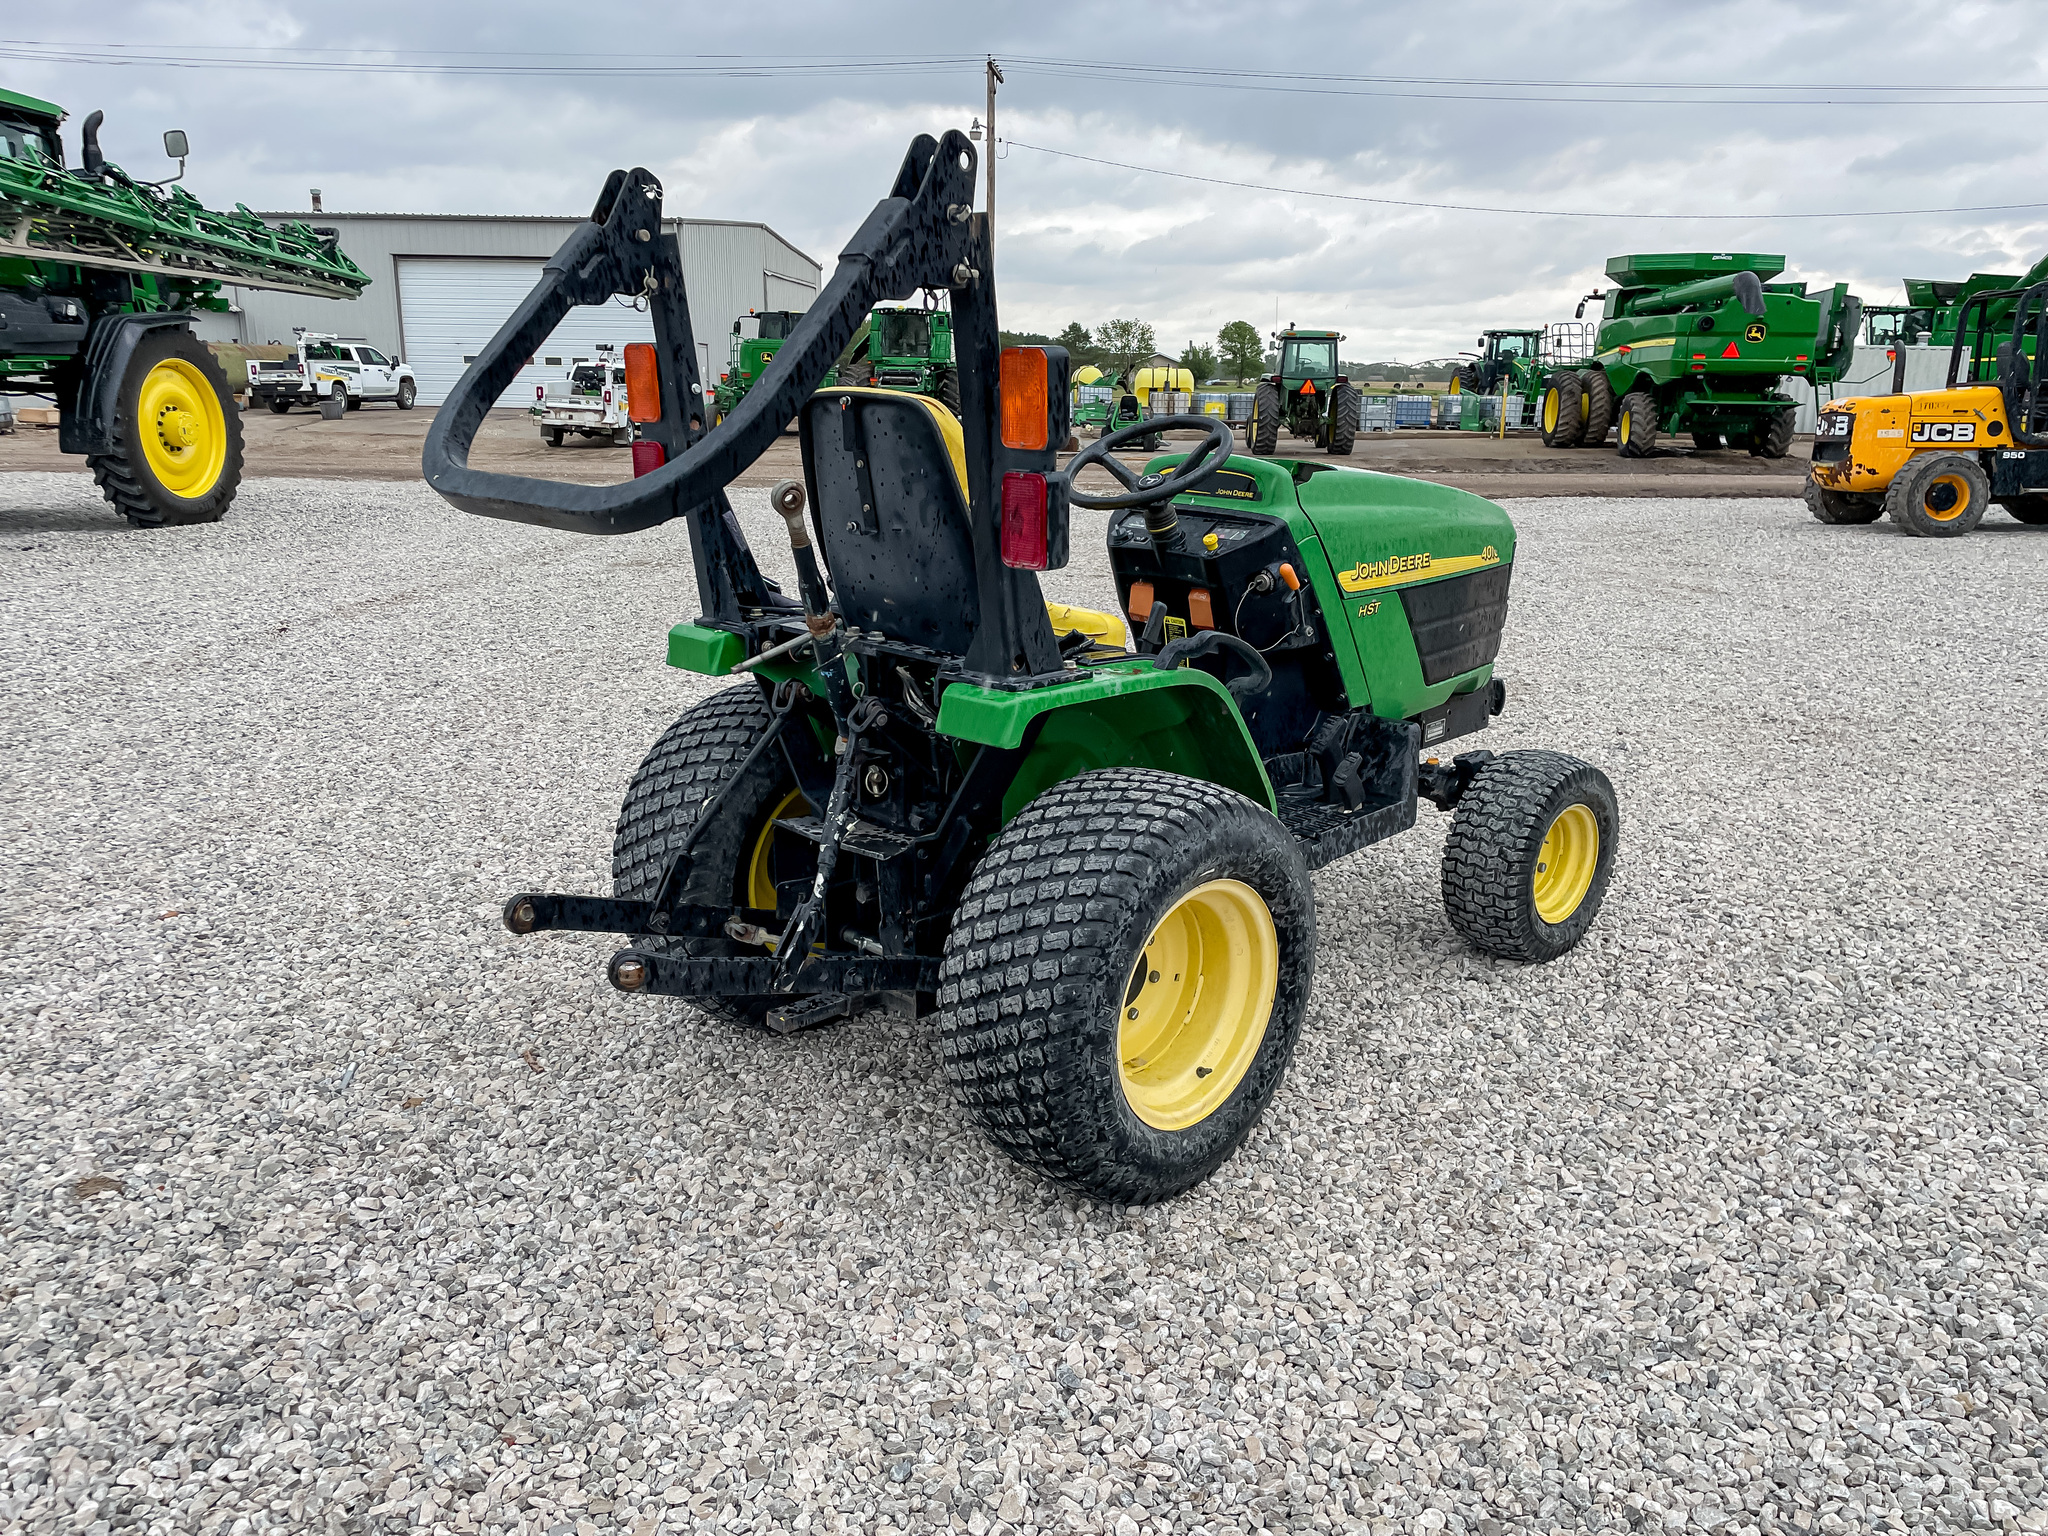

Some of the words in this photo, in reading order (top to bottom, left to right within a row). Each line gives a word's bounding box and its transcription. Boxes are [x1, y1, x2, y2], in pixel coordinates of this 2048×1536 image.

[1912, 423, 1974, 441] JCB
[2002, 451, 2026, 459] 950
[1215, 488, 1233, 496] JOHN
[1232, 489, 1254, 499] DEERE
[1351, 561, 1388, 581] JOHN
[1389, 552, 1431, 575] DEERE
[1358, 601, 1381, 618] HST
